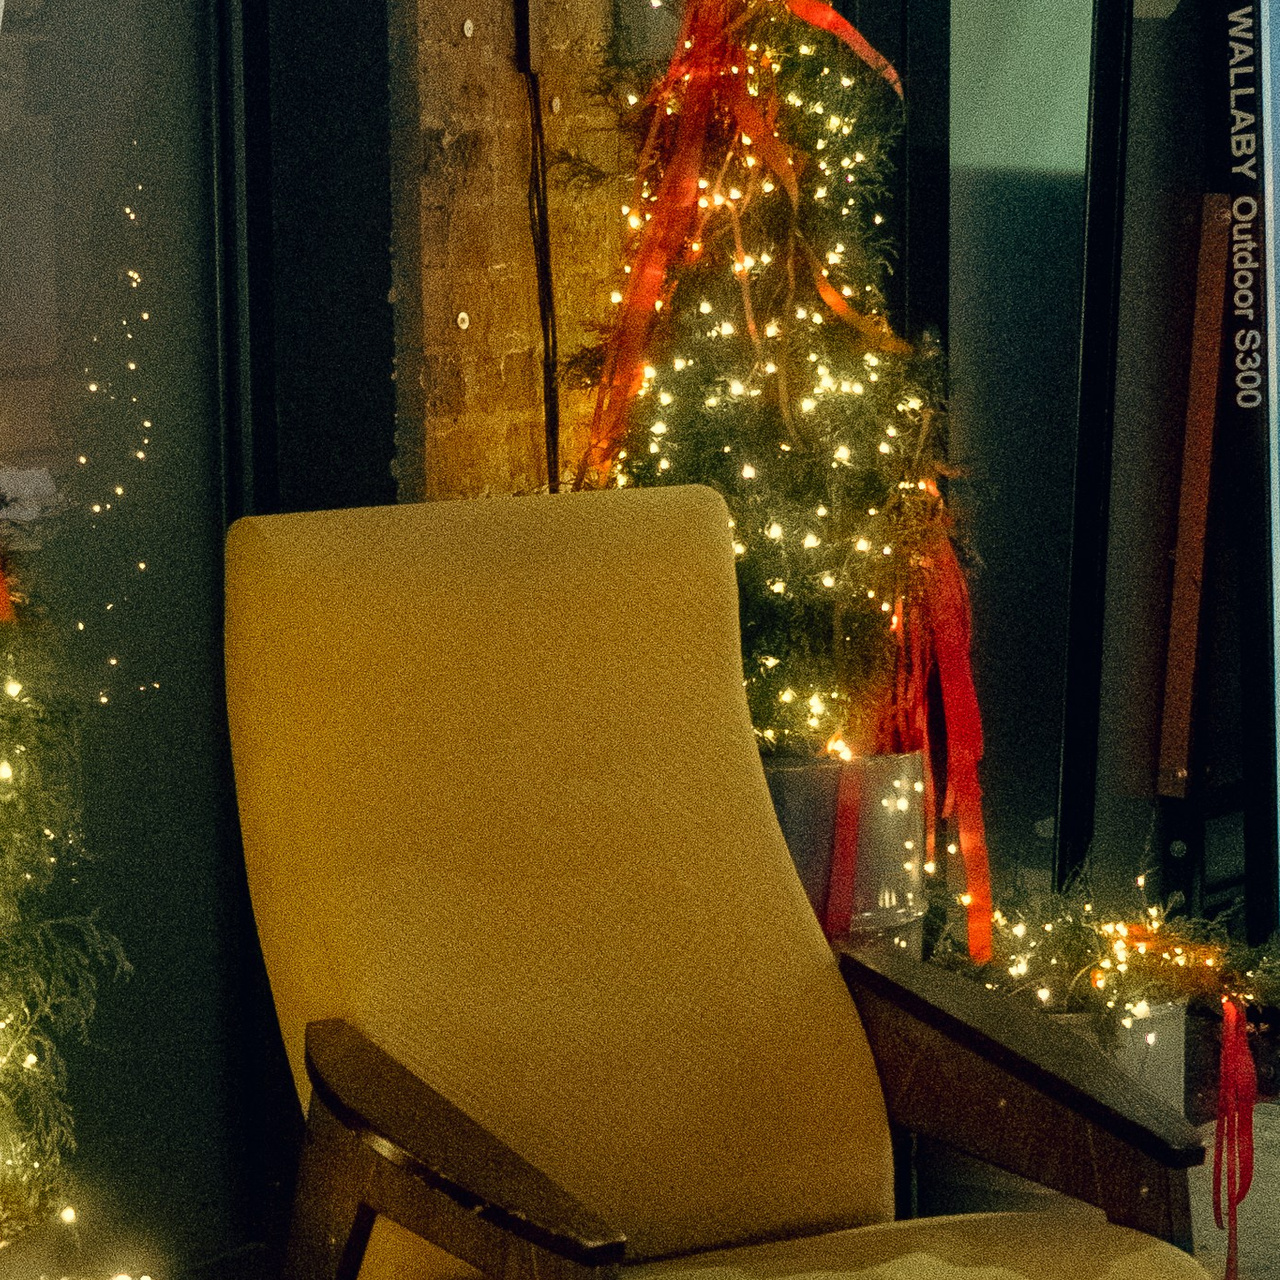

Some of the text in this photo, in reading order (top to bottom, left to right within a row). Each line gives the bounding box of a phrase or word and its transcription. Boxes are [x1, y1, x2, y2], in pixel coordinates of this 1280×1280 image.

[1228, 5, 1262, 408] WALLABY Outdoor S300
